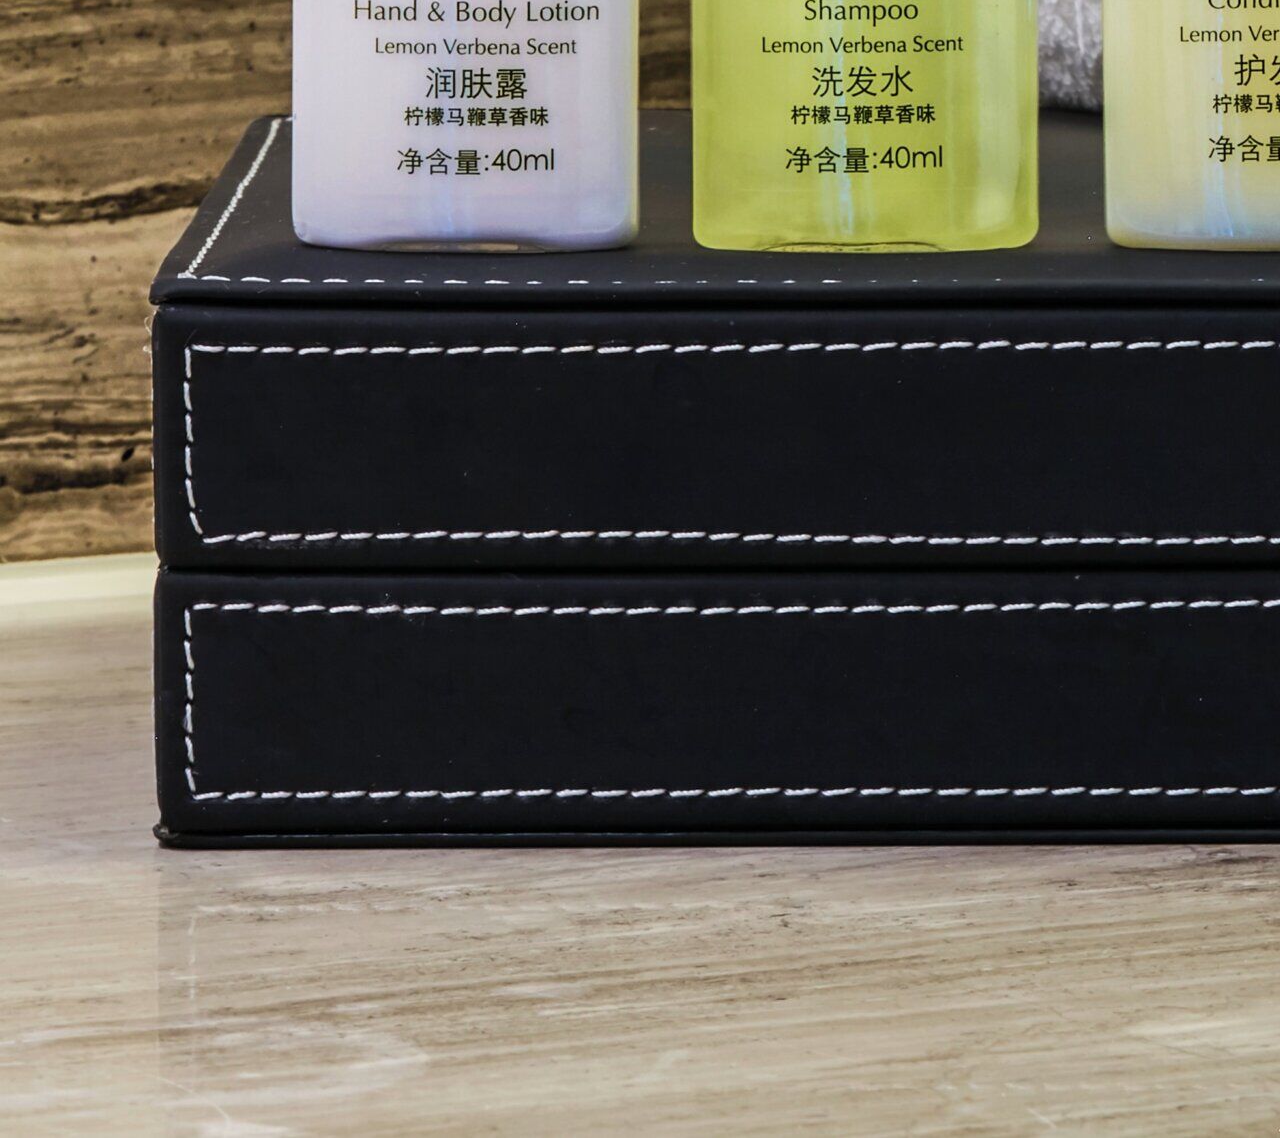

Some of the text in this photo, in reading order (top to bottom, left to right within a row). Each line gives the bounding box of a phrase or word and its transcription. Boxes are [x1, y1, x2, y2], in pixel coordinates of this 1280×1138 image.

[355, 0, 599, 29] Hand & Body Lotion
[805, 0, 918, 26] Shampoo
[376, 38, 576, 55] Lemon Verbena Scent
[762, 36, 963, 53] Lemon Verbena Scent
[1181, 26, 1242, 44] Lemon
[426, 67, 527, 99] 润肤露
[812, 65, 913, 98] 洗发水
[404, 107, 549, 127] 柠檬马鞭草香味
[791, 104, 935, 125] 柠檬马鞭草香味
[398, 148, 554, 175] 净含量:40ml
[786, 145, 942, 174] 净含量:40ml
